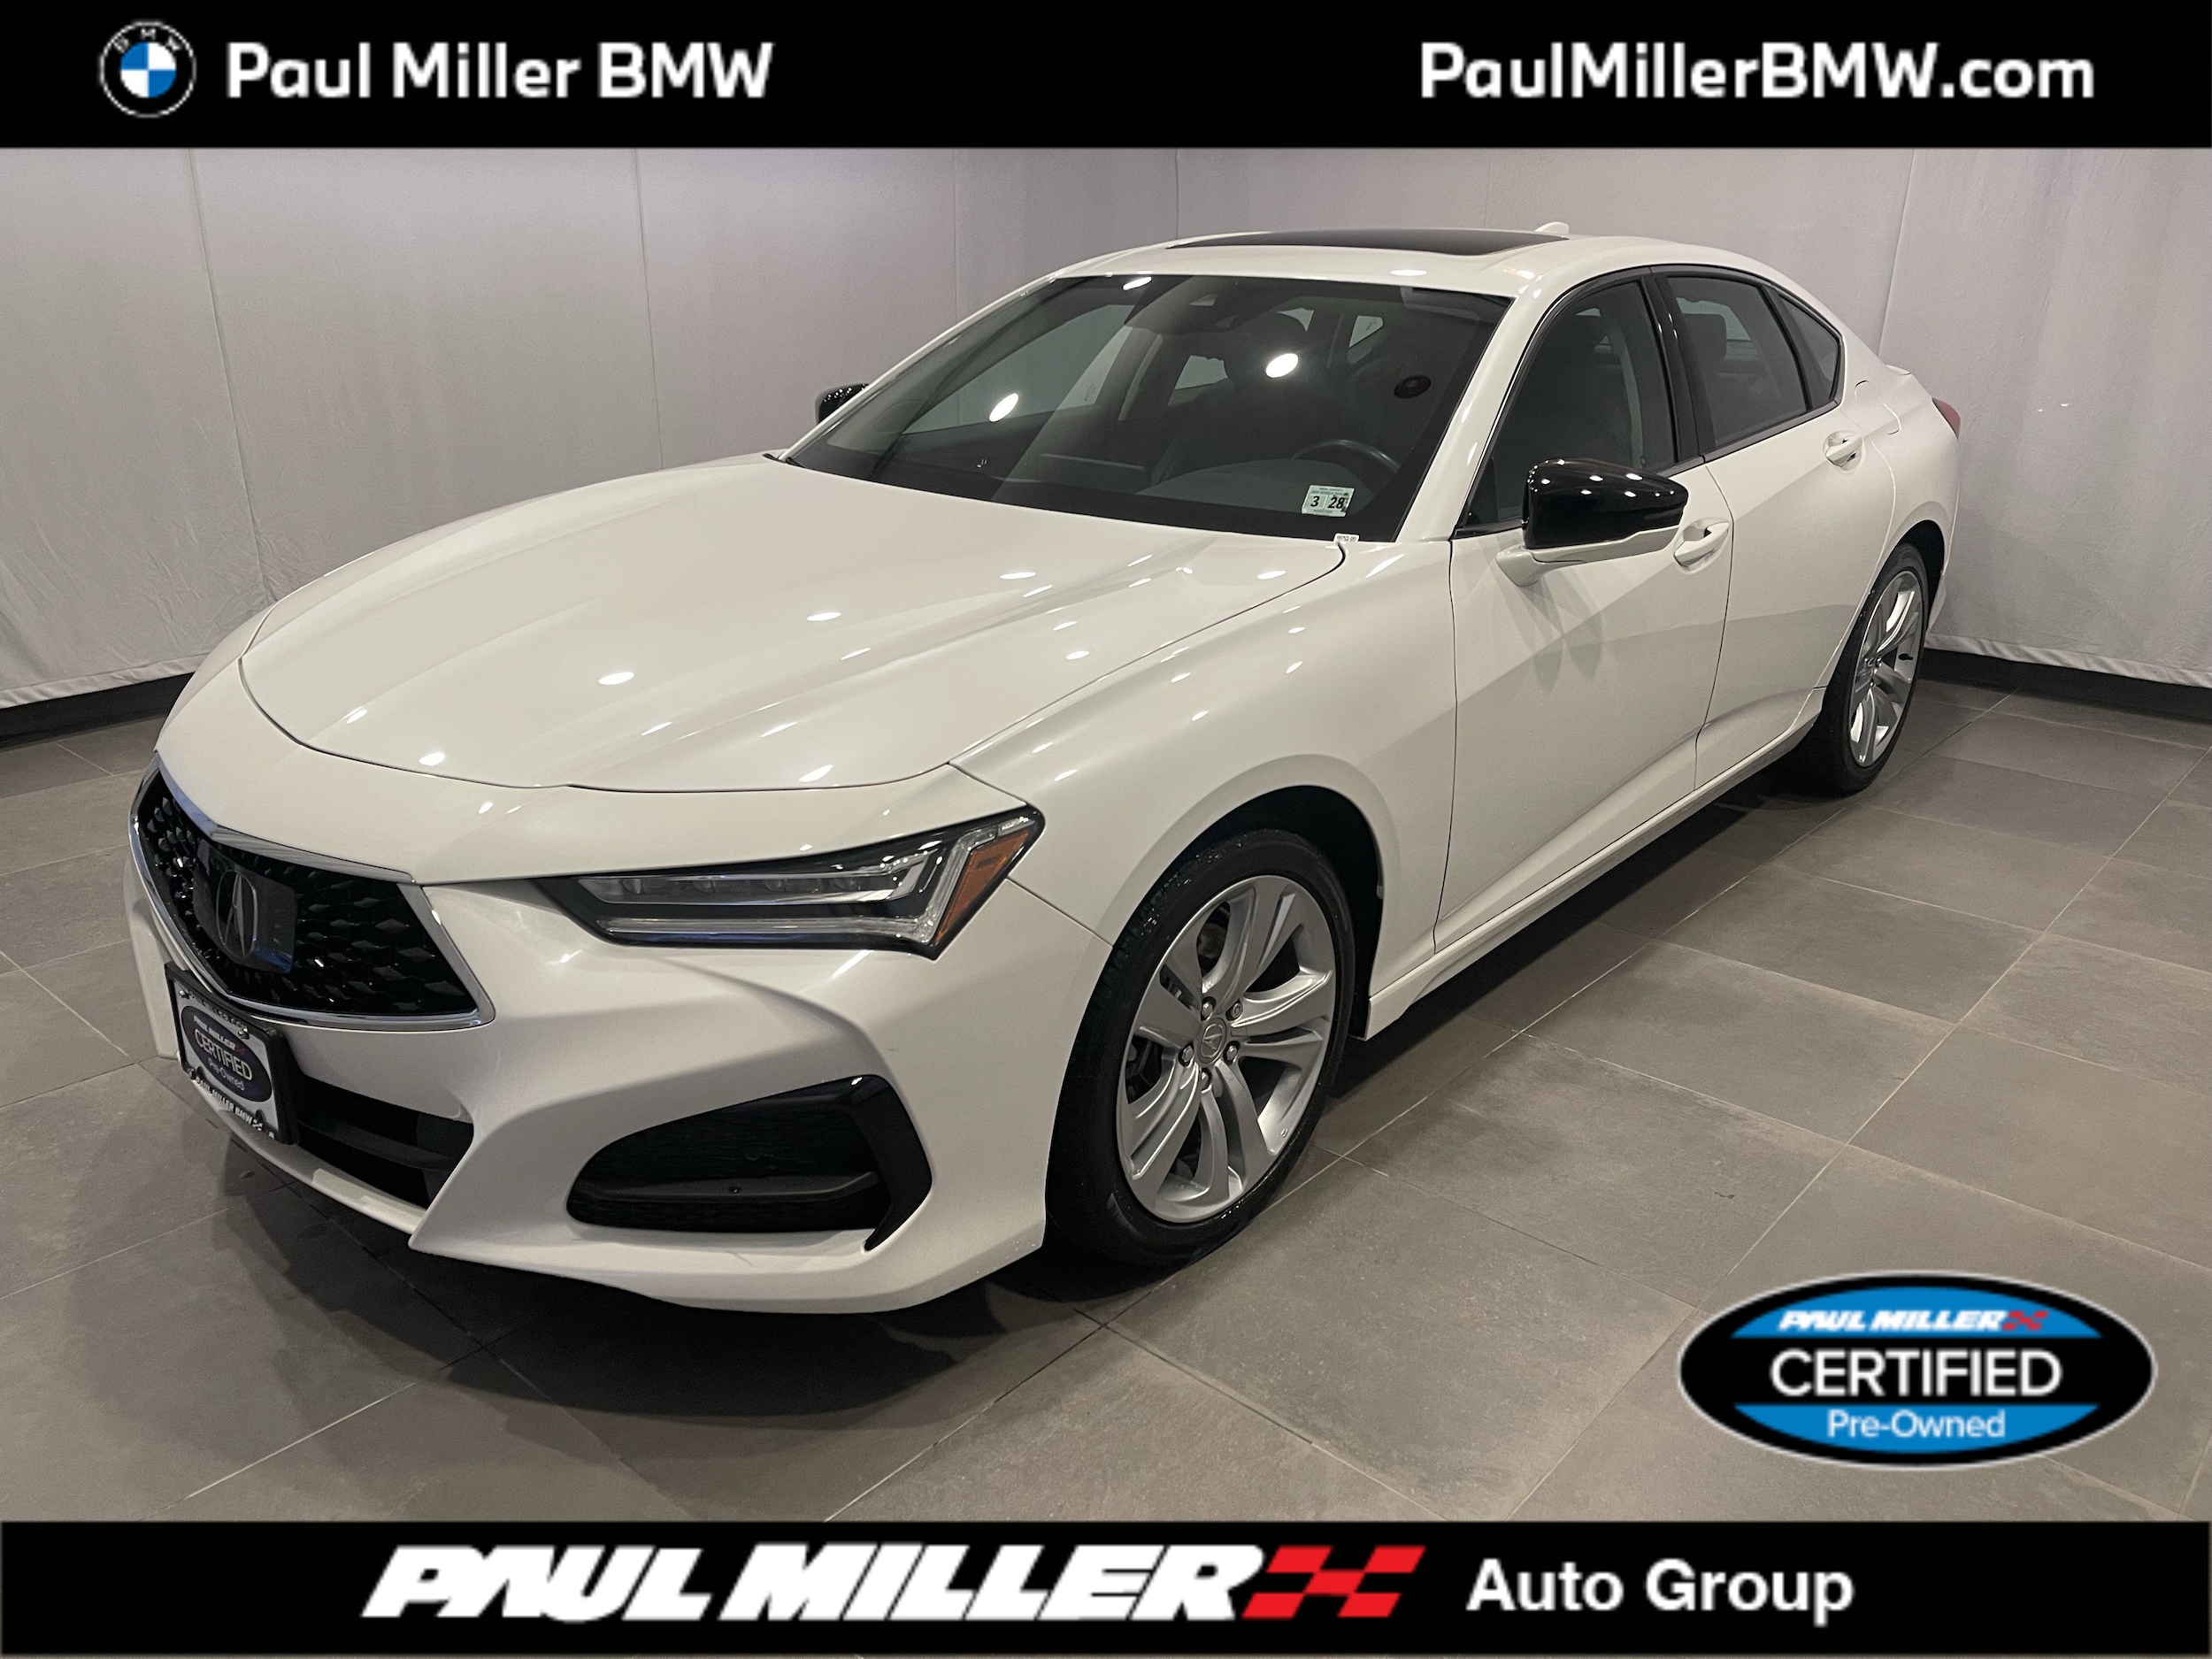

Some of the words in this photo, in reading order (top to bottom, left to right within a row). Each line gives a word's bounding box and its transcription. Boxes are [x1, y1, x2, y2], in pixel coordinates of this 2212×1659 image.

[1310, 495, 1319, 507] 3
[1327, 496, 1345, 510] 28
[195, 1028, 252, 1080] CERTIFIED
[208, 1026, 236, 1051] MILLER
[208, 1057, 245, 1091] Pre-Owned
[196, 1076, 211, 1093] PAUL
[211, 1089, 234, 1113] MILLER
[234, 1107, 253, 1125] BMW
